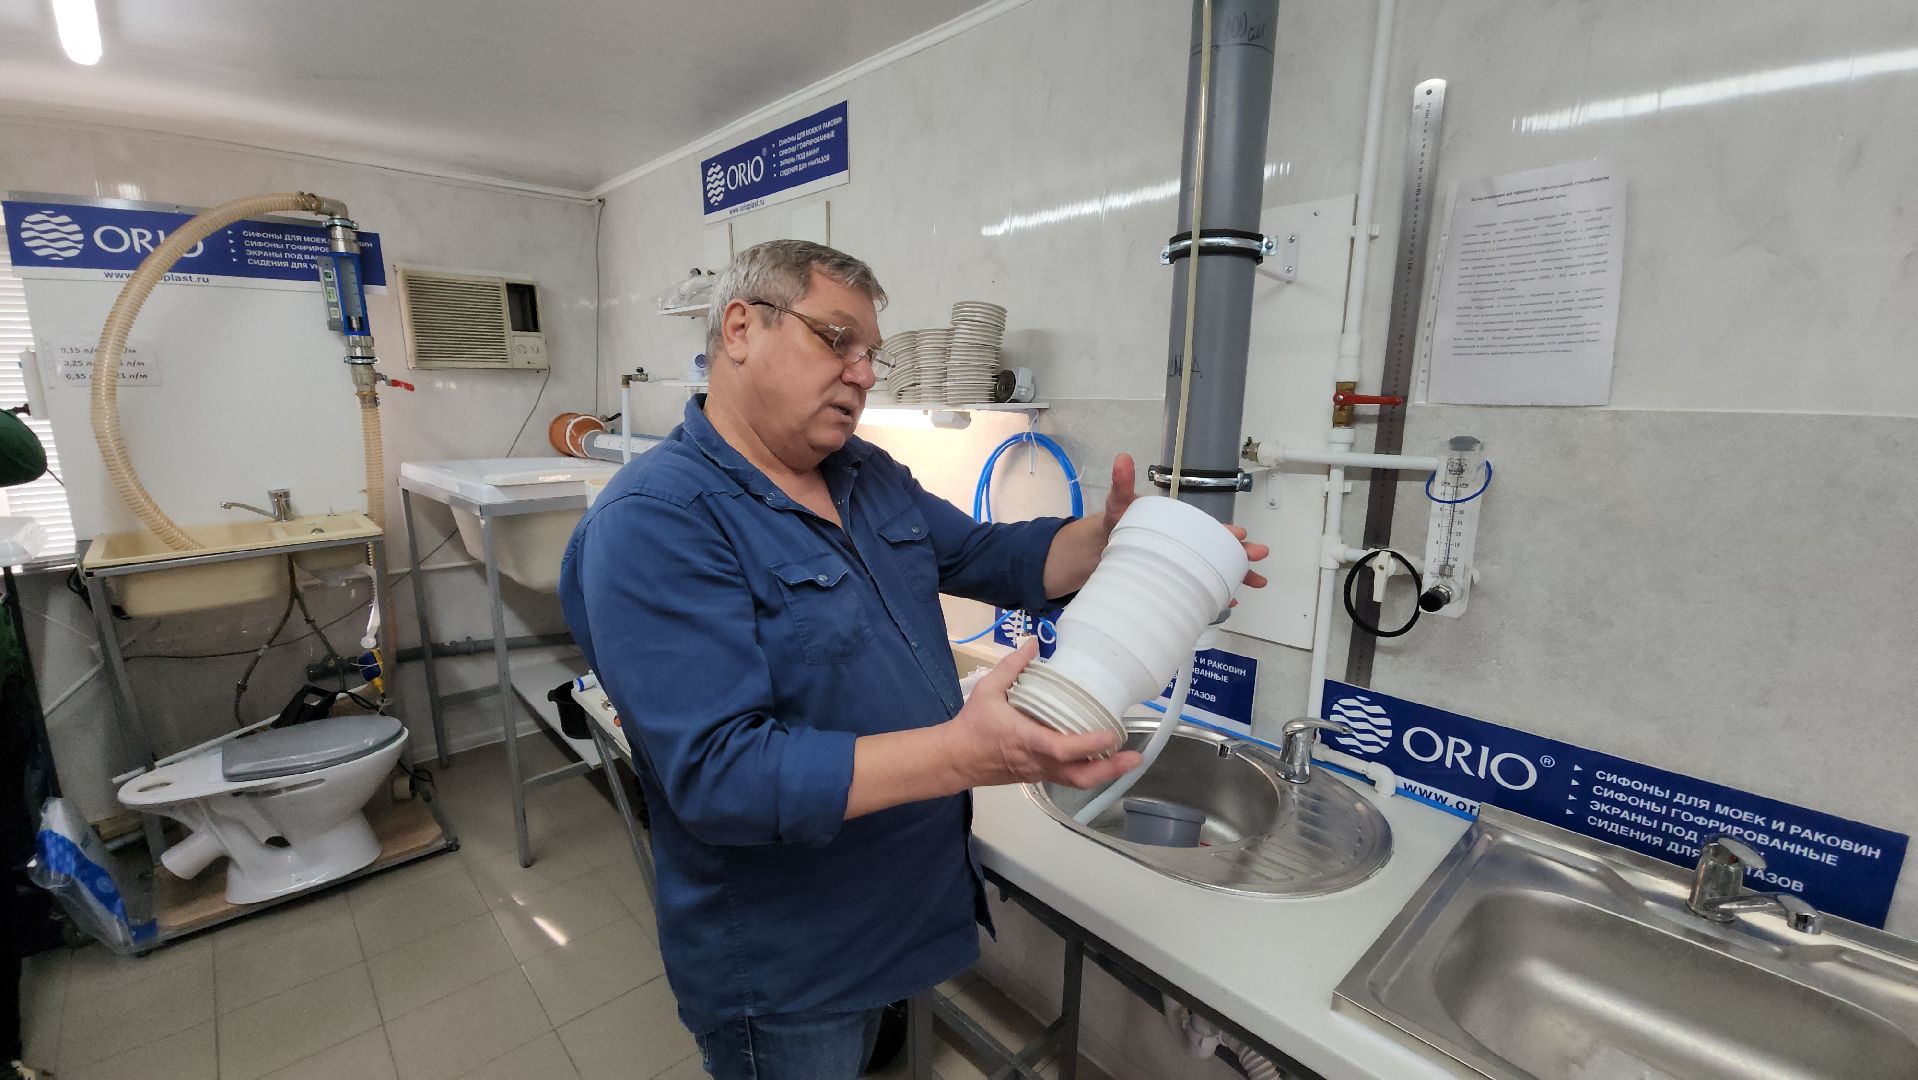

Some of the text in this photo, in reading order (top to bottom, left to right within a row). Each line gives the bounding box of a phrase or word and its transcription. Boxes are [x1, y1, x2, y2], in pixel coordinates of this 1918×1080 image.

[726, 155, 764, 191] ORIO
[93, 225, 203, 258] OR
[242, 230, 327, 244] СИФОНЫ ДЛЯ МОЕК
[244, 240, 284, 249] СИФОНЫ
[246, 249, 283, 258] ЭКРАНЫ
[284, 252, 303, 261] ПОД
[247, 258, 289, 267] СИДЕНИЯ
[290, 261, 308, 269] ДЛЯ
[1199, 657, 1206, 665] И
[1207, 659, 1247, 677] РАКОВИН
[1402, 726, 1538, 791] ORIO
[1589, 800, 1699, 844] ЭКРАНЫ ПОД
[1592, 784, 1839, 867] СИФОНЫ ГОФРИРОВАННЫЕ
[1595, 769, 1882, 860] СИФОНЫ ДЛЯ МОЕК И РАКОВИН
[1587, 814, 1804, 893] СИДЕНИЯ ДЛЯ ТАЗОВ
